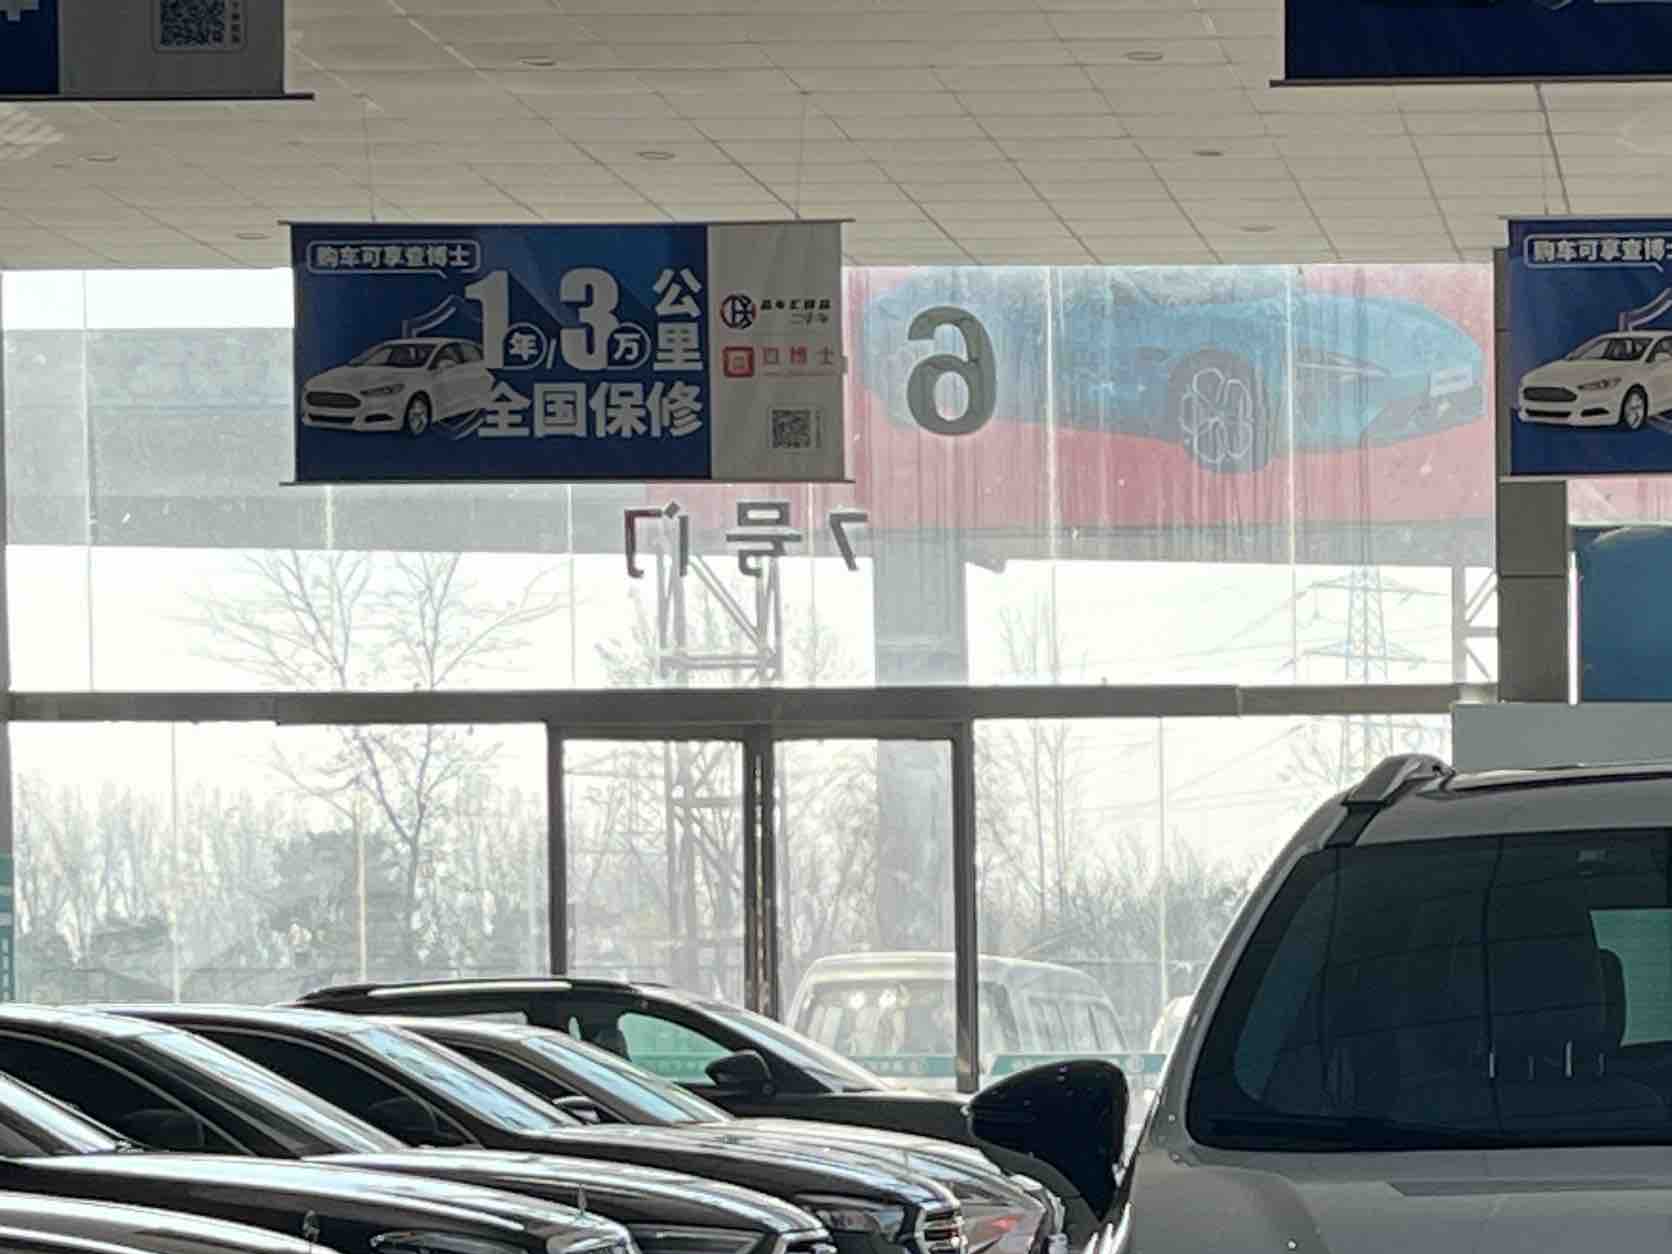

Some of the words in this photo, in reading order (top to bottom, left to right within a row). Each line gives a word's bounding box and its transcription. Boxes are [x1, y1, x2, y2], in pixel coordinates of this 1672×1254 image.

[316, 243, 470, 271] 购车可享查博士
[479, 382, 704, 440] 全国保修
